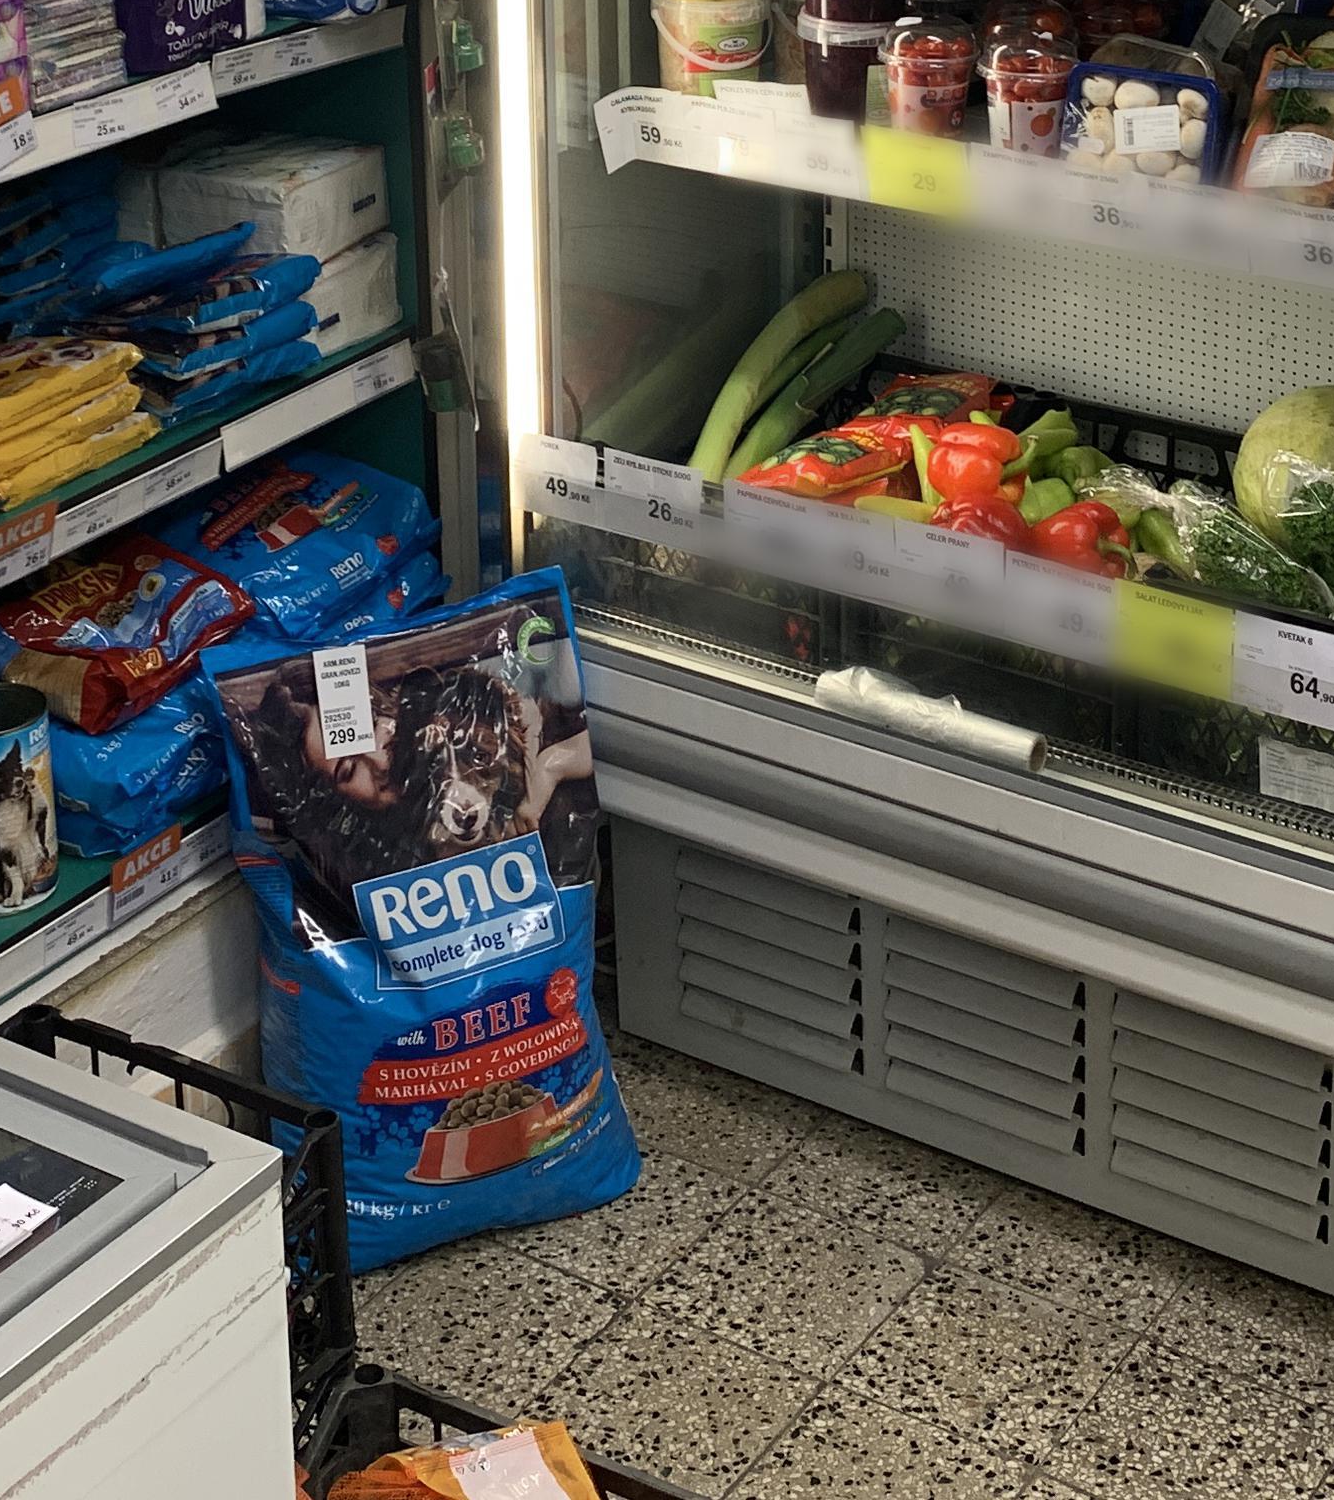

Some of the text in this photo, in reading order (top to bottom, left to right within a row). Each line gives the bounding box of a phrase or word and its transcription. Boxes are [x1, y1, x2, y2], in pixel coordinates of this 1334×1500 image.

[329, 551, 364, 580] Reno
[123, 835, 172, 881] AKCE
[369, 851, 537, 941] Reno
[392, 931, 505, 974] complete dog
[397, 992, 532, 1051] with BEEF
[379, 1050, 501, 1081] S HOVĚZÍM Z
[375, 1079, 468, 1099] MARHÁVAL
